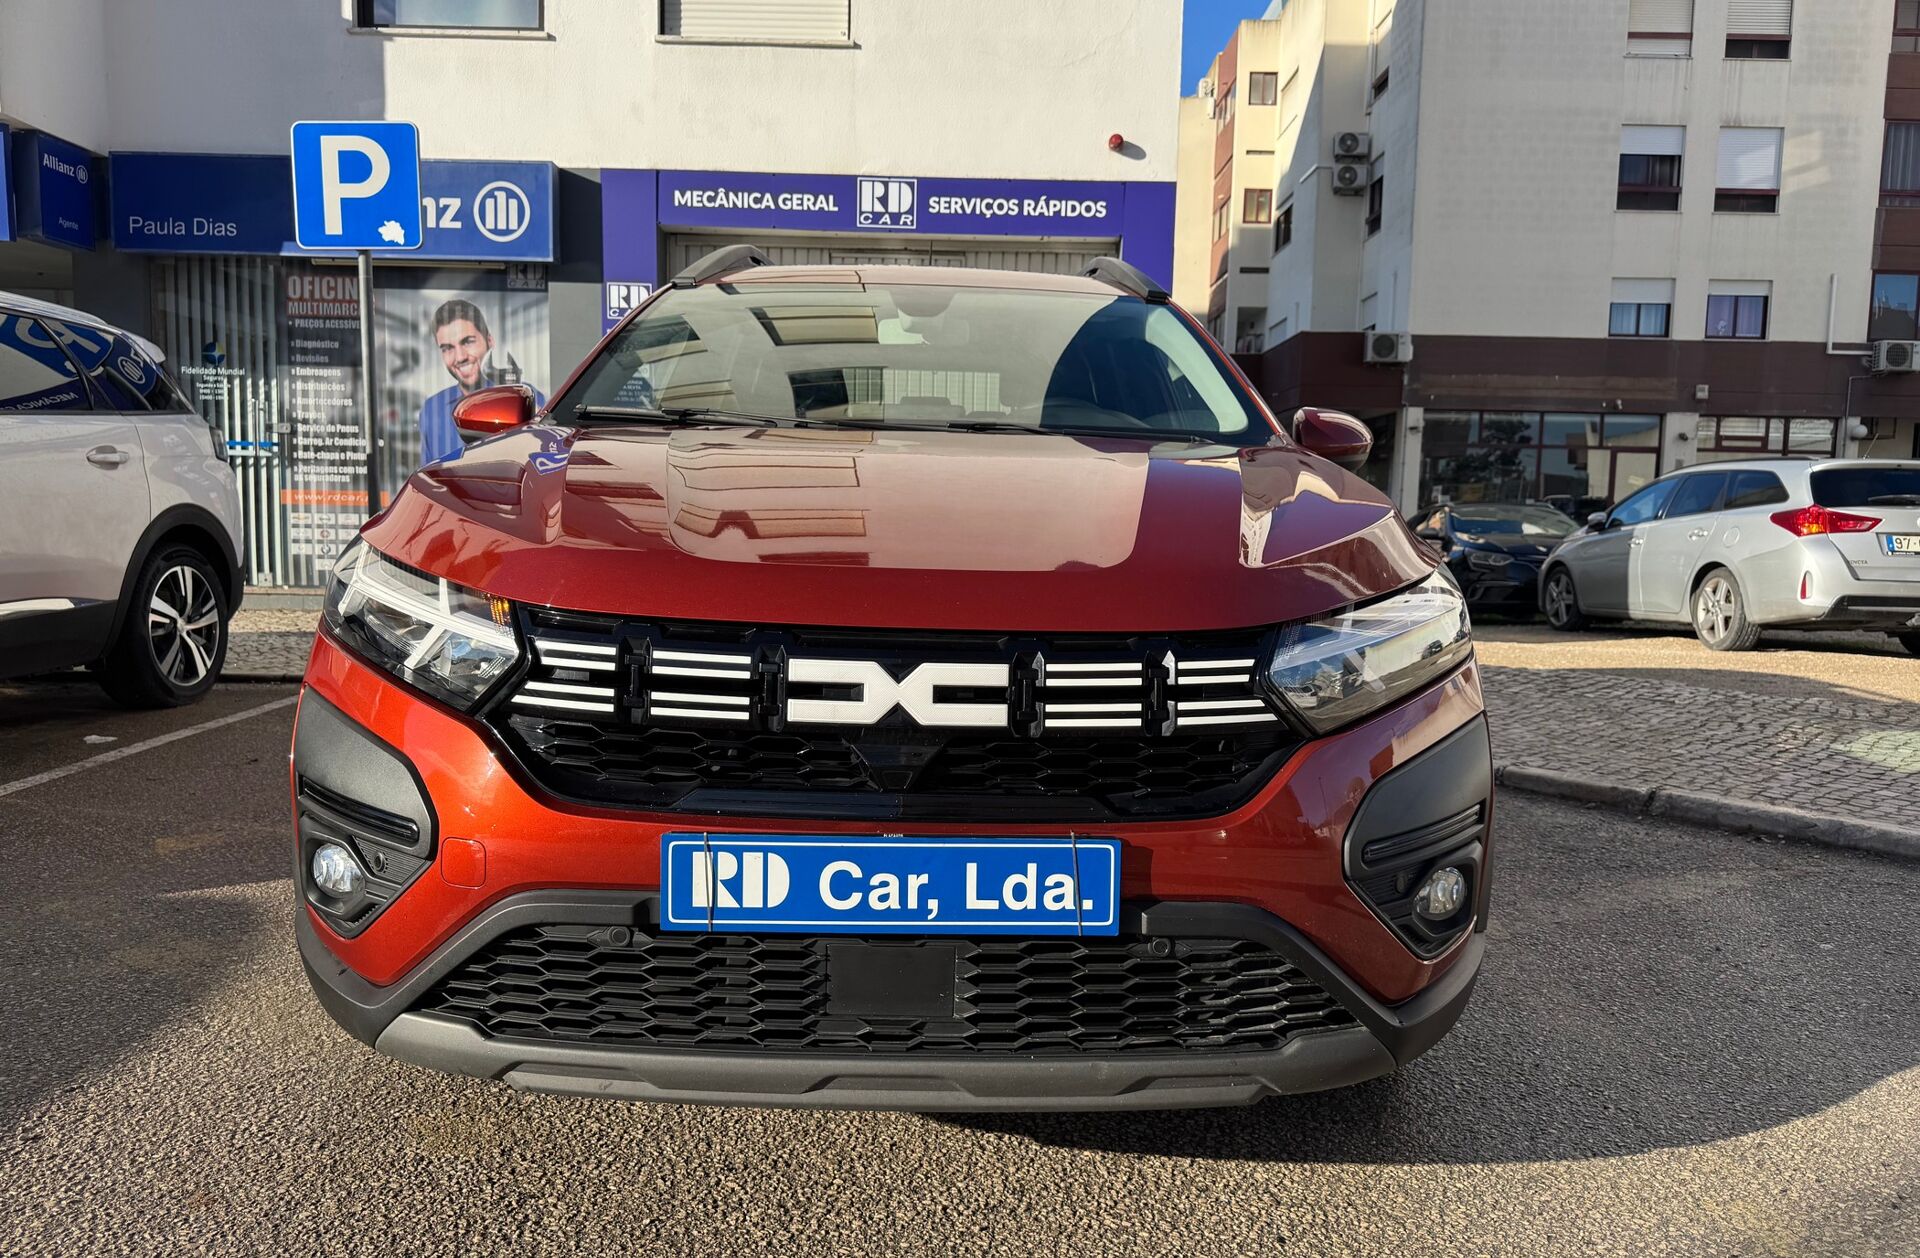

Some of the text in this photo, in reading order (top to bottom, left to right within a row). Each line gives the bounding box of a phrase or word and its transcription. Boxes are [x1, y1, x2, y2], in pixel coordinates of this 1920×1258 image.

[43, 153, 75, 177] Allianz
[320, 134, 391, 236] P
[674, 188, 838, 212] MECÂNICA GERAL
[861, 180, 913, 213] RD
[928, 195, 1107, 219] SERVIÇOS RÁPIDOS
[58, 217, 79, 230] Agente
[860, 213, 913, 226] CAR
[129, 216, 237, 237] Paula Dias
[288, 275, 358, 300] OFICIN
[288, 302, 360, 316] MULTIMARC
[295, 319, 361, 330] PREÇOS ACESSÍVE
[295, 340, 339, 350] Diagnóstico
[296, 354, 329, 363] Revisões
[181, 366, 245, 376] Fidelidade Mundial
[296, 367, 342, 378] Embreagens
[296, 381, 346, 391] Distribuições
[296, 397, 353, 407] Amortecedores
[297, 423, 360, 433] Serviço de Pneus
[325, 437, 333, 446] Ar
[338, 466, 355, 474] com
[355, 465, 368, 474] tod
[692, 850, 1094, 921] RD Car, Lda.
